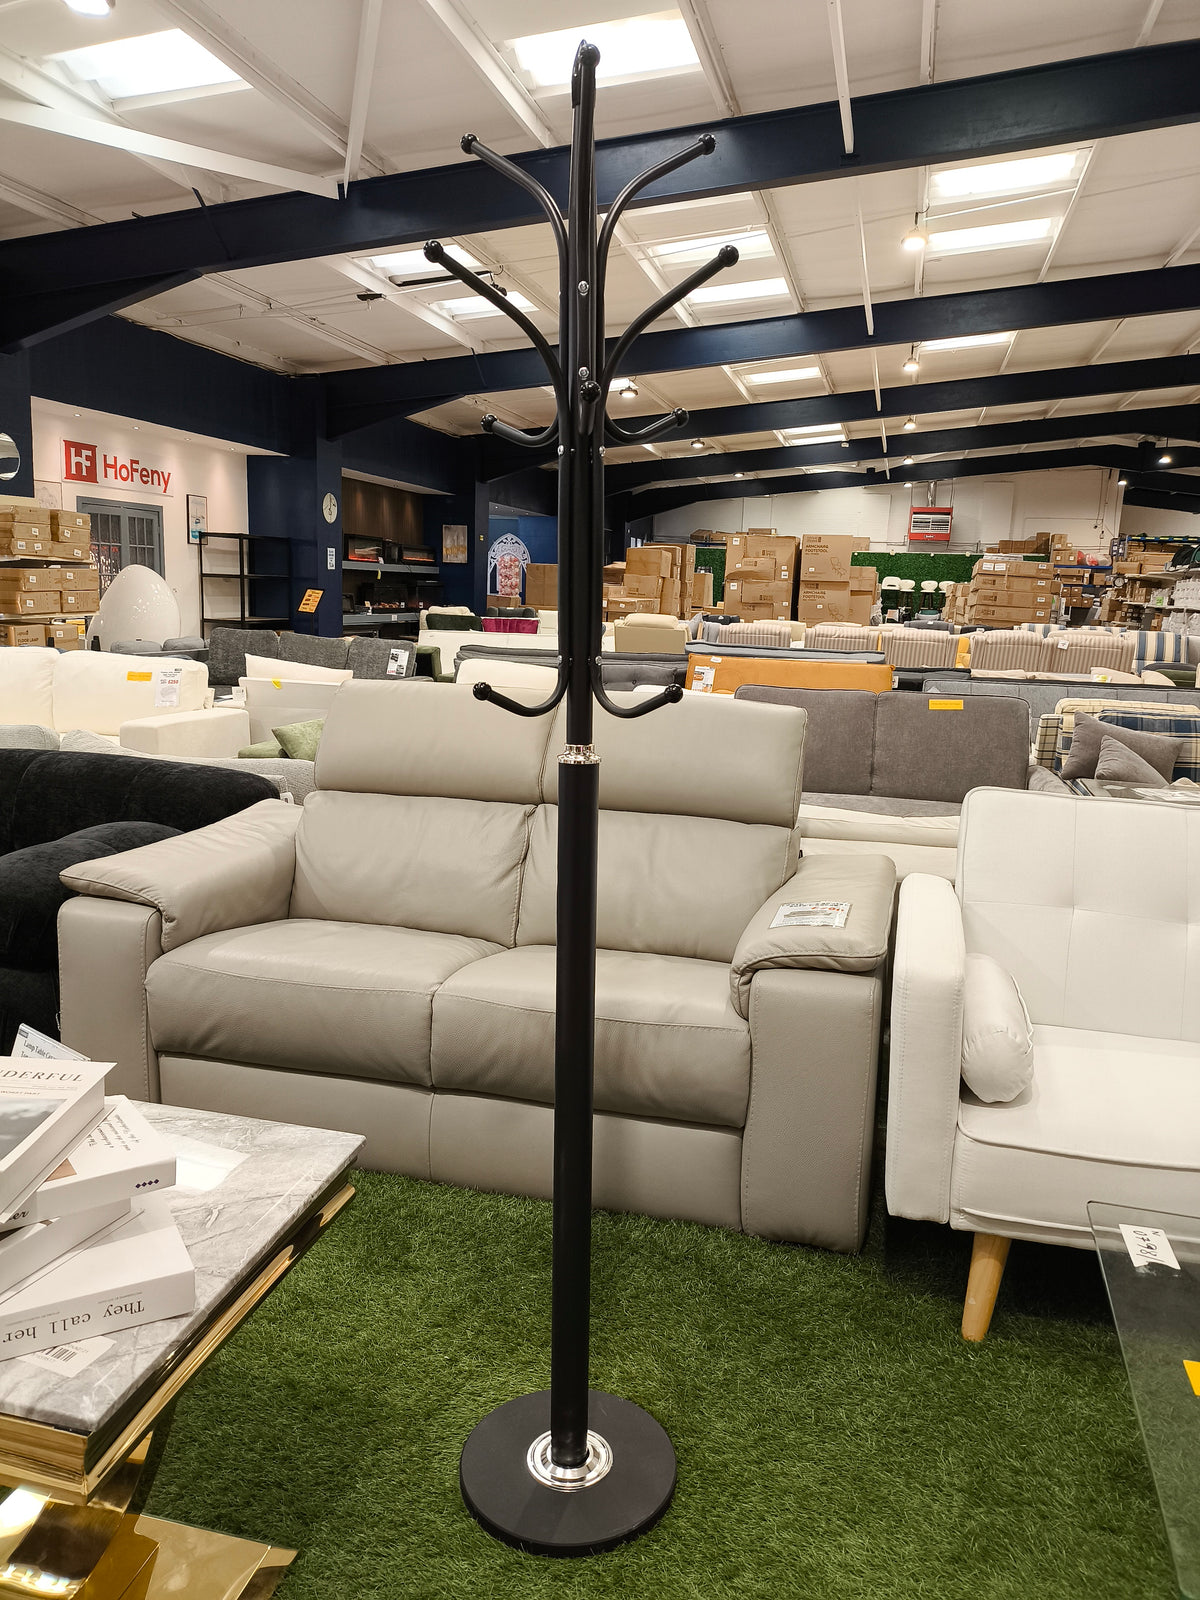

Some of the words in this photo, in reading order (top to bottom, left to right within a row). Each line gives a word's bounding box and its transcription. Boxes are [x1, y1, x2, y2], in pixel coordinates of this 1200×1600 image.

[103, 454, 171, 493] HoFeny
[0, 1069, 83, 1082] DERFUL
[103, 1300, 145, 1318] They
[49, 1313, 91, 1334] call
[2, 1326, 37, 1342] her
